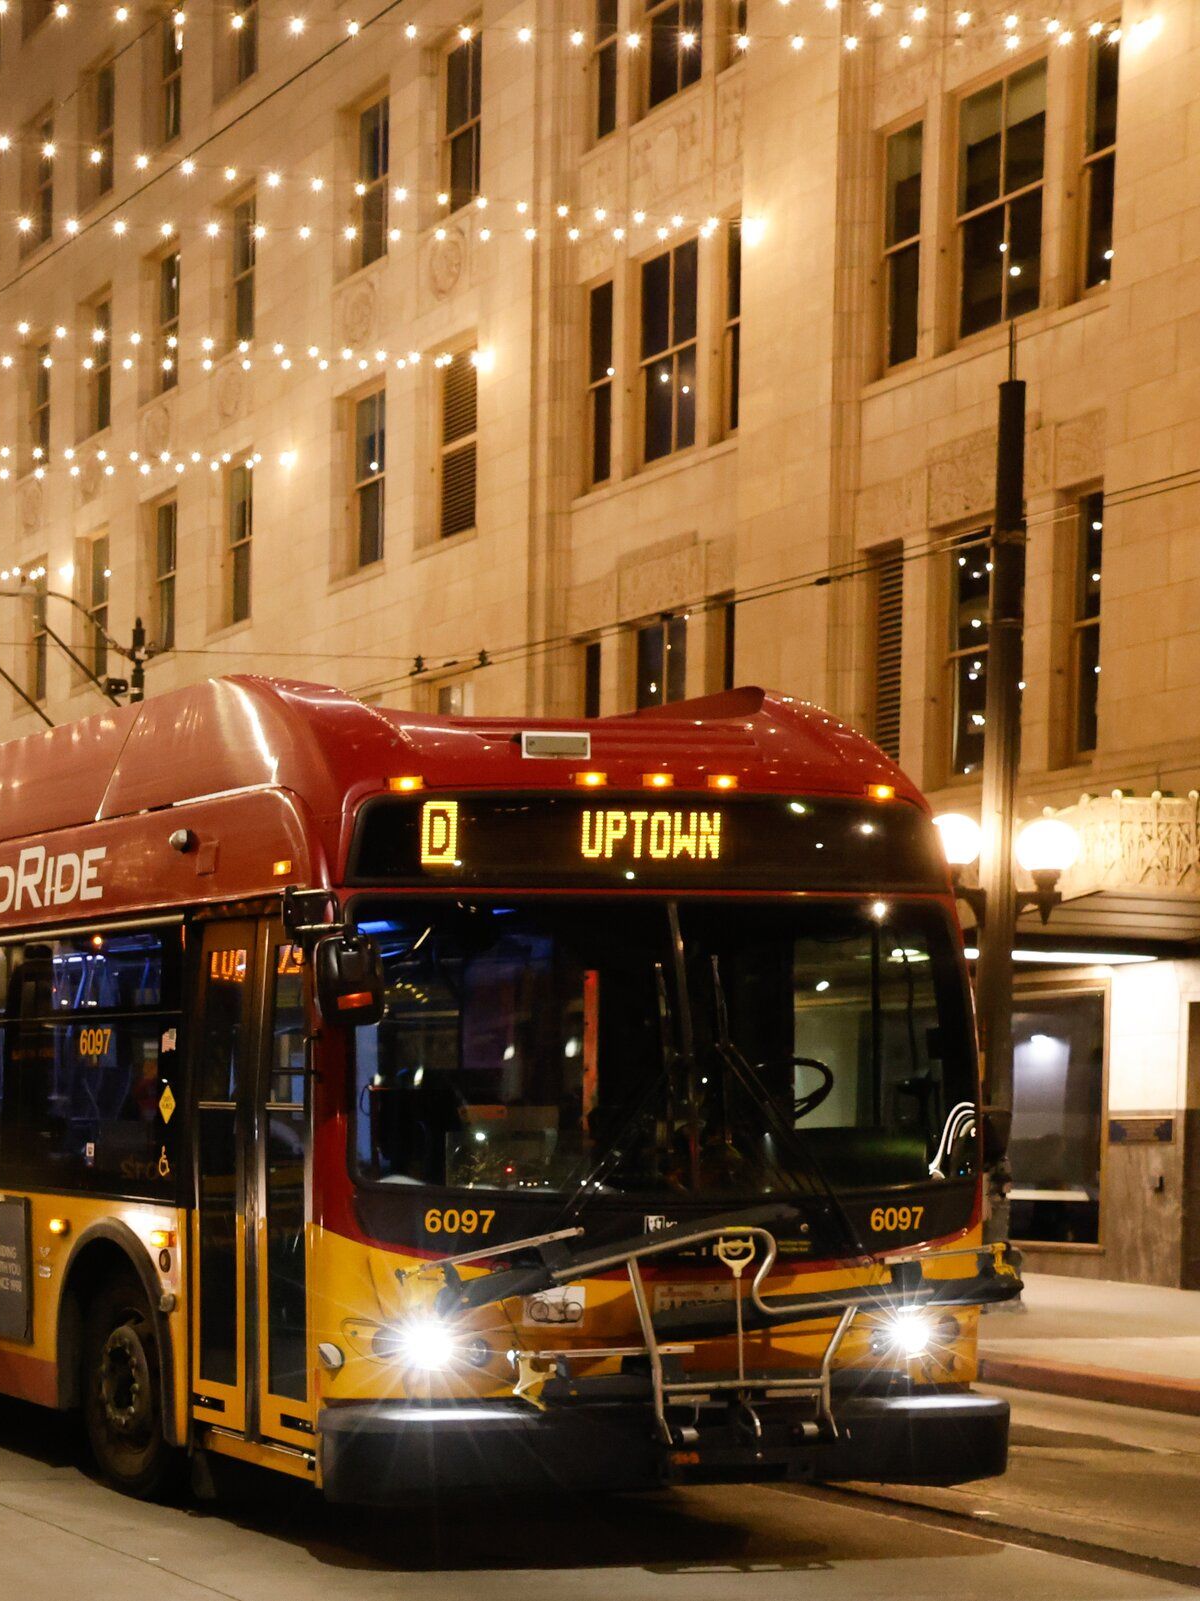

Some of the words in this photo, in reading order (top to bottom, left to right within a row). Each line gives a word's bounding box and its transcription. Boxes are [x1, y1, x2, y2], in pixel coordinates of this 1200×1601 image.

[425, 805, 454, 859] D
[581, 811, 721, 858] UPTOWN
[80, 1029, 112, 1054] 6097
[424, 1209, 495, 1233] 6097
[870, 1207, 923, 1231] 6097
